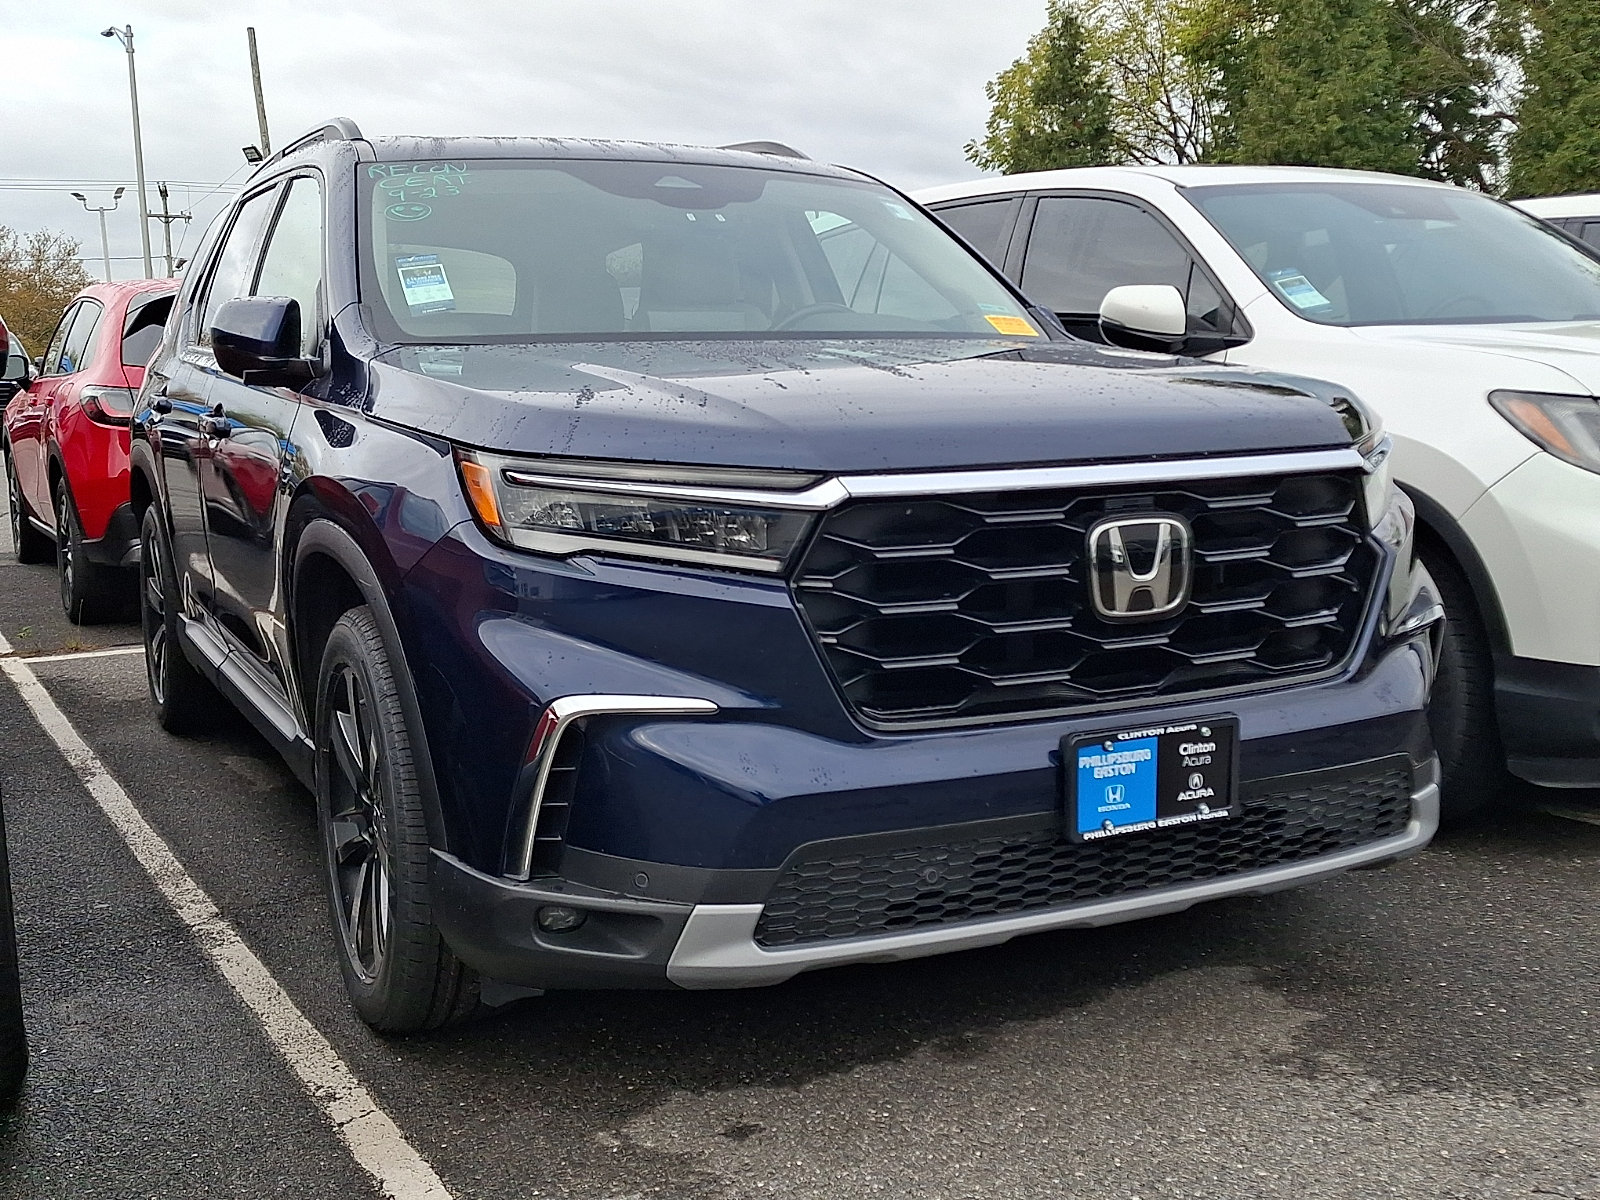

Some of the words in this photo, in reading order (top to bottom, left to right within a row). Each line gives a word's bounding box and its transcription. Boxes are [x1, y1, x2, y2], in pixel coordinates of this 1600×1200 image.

[367, 162, 467, 178] RECON
[1117, 729, 1165, 740] CLINTON
[1179, 742, 1216, 756] Clinton
[1078, 749, 1151, 768] PHILLIPSBURG
[1181, 755, 1212, 768] Acura
[1094, 763, 1135, 778] EASTON
[1177, 787, 1214, 801] ACURA
[1157, 814, 1197, 828] EASTON
